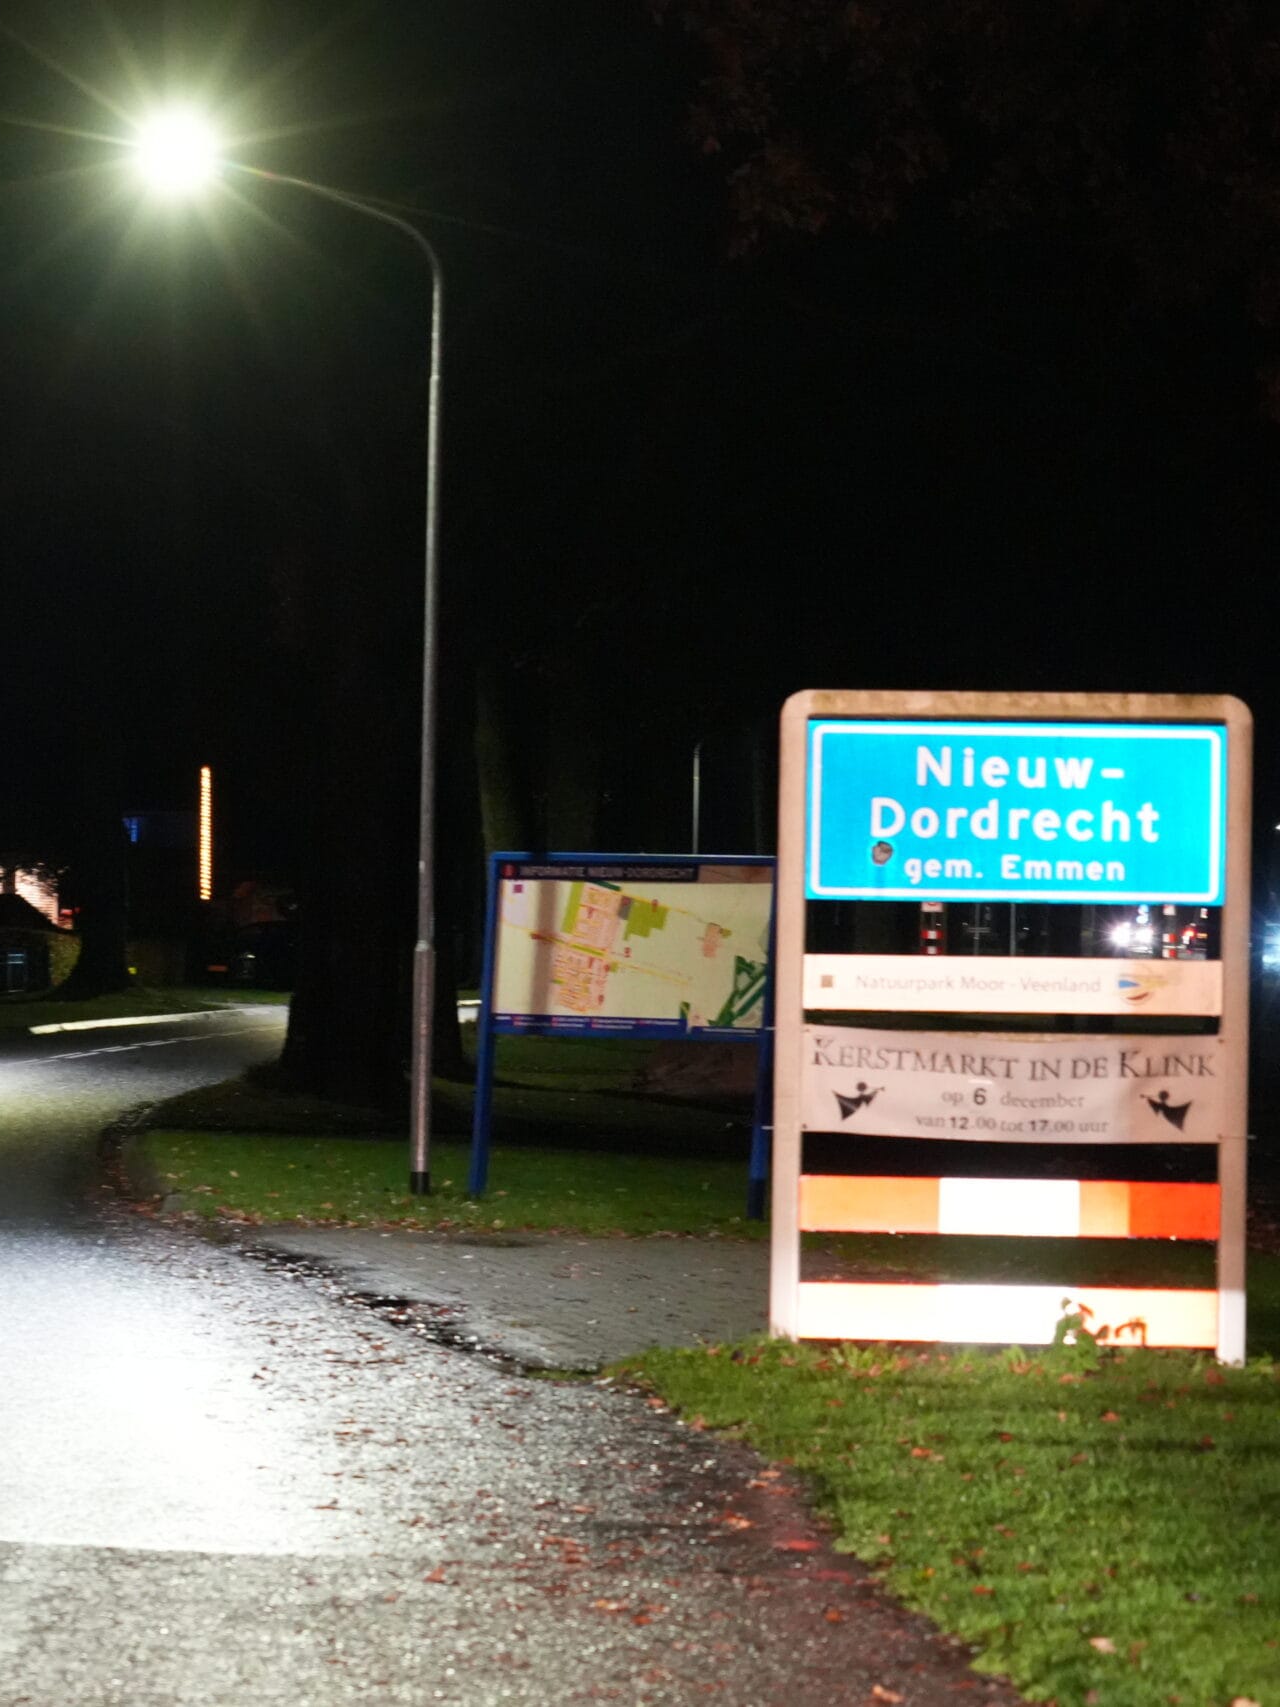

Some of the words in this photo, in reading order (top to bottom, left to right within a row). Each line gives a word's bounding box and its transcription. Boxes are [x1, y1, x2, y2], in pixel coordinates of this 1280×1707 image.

[916, 745, 1125, 790] Nieuw-
[870, 797, 1161, 843] Dordrecht
[904, 856, 983, 884] gem.
[1001, 854, 1126, 881] Emmen
[856, 975, 954, 994] Natuurpark
[812, 1037, 1019, 1079] KERSTMARKT
[1028, 1058, 1062, 1081] IN
[1071, 1056, 1109, 1079] DE
[1118, 1049, 1216, 1078] KLINK
[941, 1091, 964, 1106] op
[973, 1088, 987, 1106] 6
[1000, 1091, 1085, 1108] december
[916, 1115, 946, 1129] van
[1000, 1117, 1024, 1132] tot
[1029, 1119, 1075, 1132] 17.00
[1078, 1120, 1110, 1133] uur
